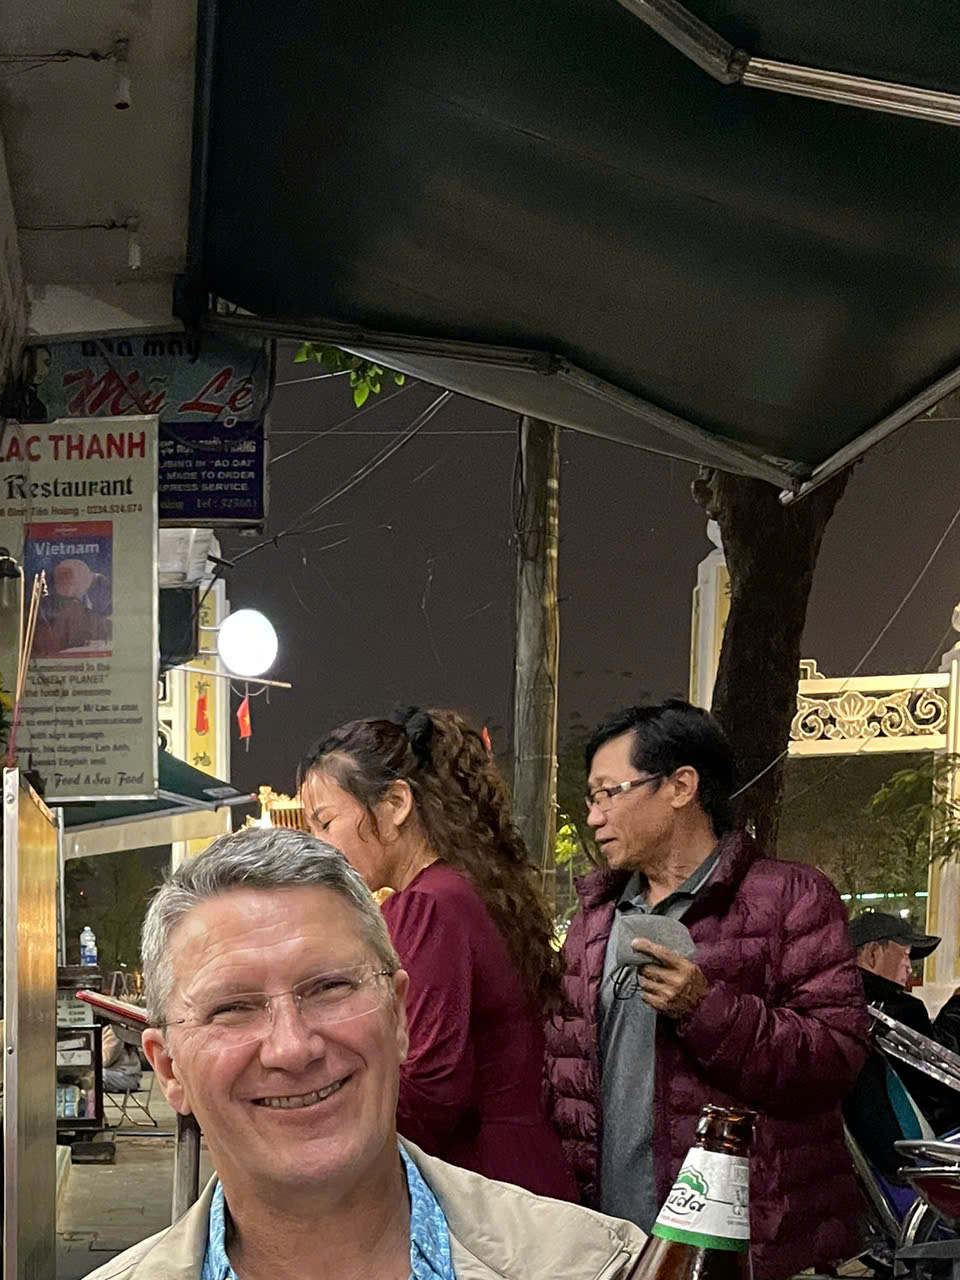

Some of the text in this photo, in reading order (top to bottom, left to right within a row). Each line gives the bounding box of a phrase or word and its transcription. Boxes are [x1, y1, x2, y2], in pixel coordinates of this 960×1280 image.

[48, 431, 146, 462] THANH
[201, 471, 215, 480] TO
[217, 470, 256, 480] ORDER
[3, 473, 133, 500] Restaurant
[201, 482, 249, 492] SERVICE
[33, 541, 101, 556] Vietnam
[116, 771, 145, 787] Food
